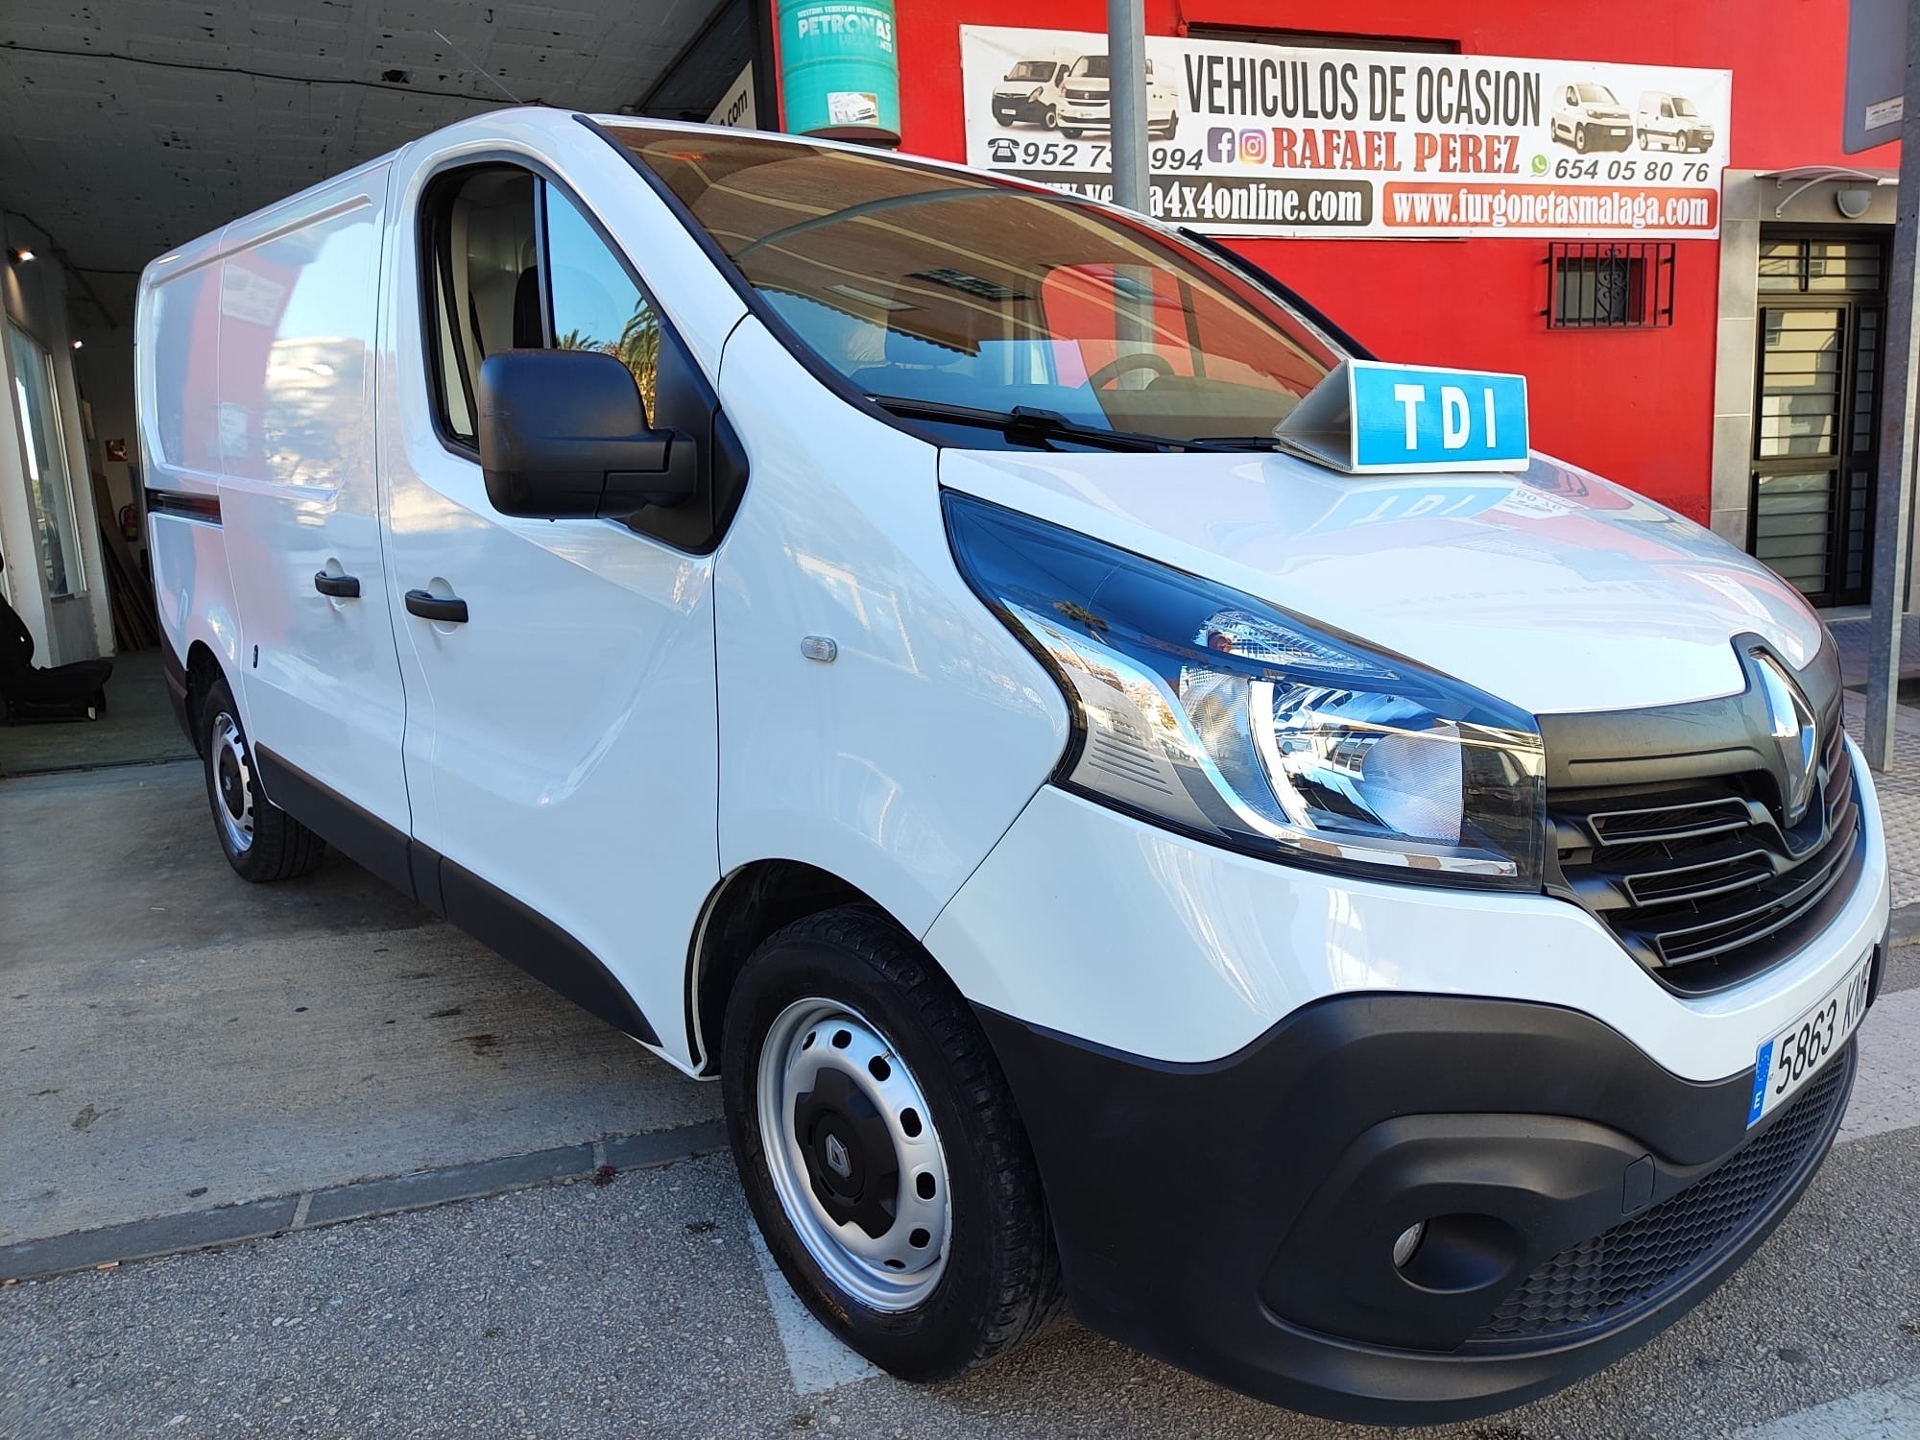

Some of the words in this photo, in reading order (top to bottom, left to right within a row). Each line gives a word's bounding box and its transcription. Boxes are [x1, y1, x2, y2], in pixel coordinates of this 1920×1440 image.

[797, 14, 892, 42] PETRONAS
[1183, 53, 1359, 121] VEHICULOS
[1368, 64, 1406, 123] DE
[1415, 66, 1540, 127] OCASION
[1021, 142, 1078, 167] 952
[1150, 147, 1204, 171] 994
[1271, 126, 1402, 172] RAFAEL
[1413, 132, 1520, 174] PEREZ
[1554, 158, 1599, 180] 654
[1607, 160, 1636, 181] 05
[1644, 161, 1673, 182] 80
[1682, 162, 1710, 183] 76
[1392, 188, 1709, 229] www.furgonetasmalaga.com
[1393, 383, 1498, 450] TDI
[1775, 998, 1838, 1095] 5863
